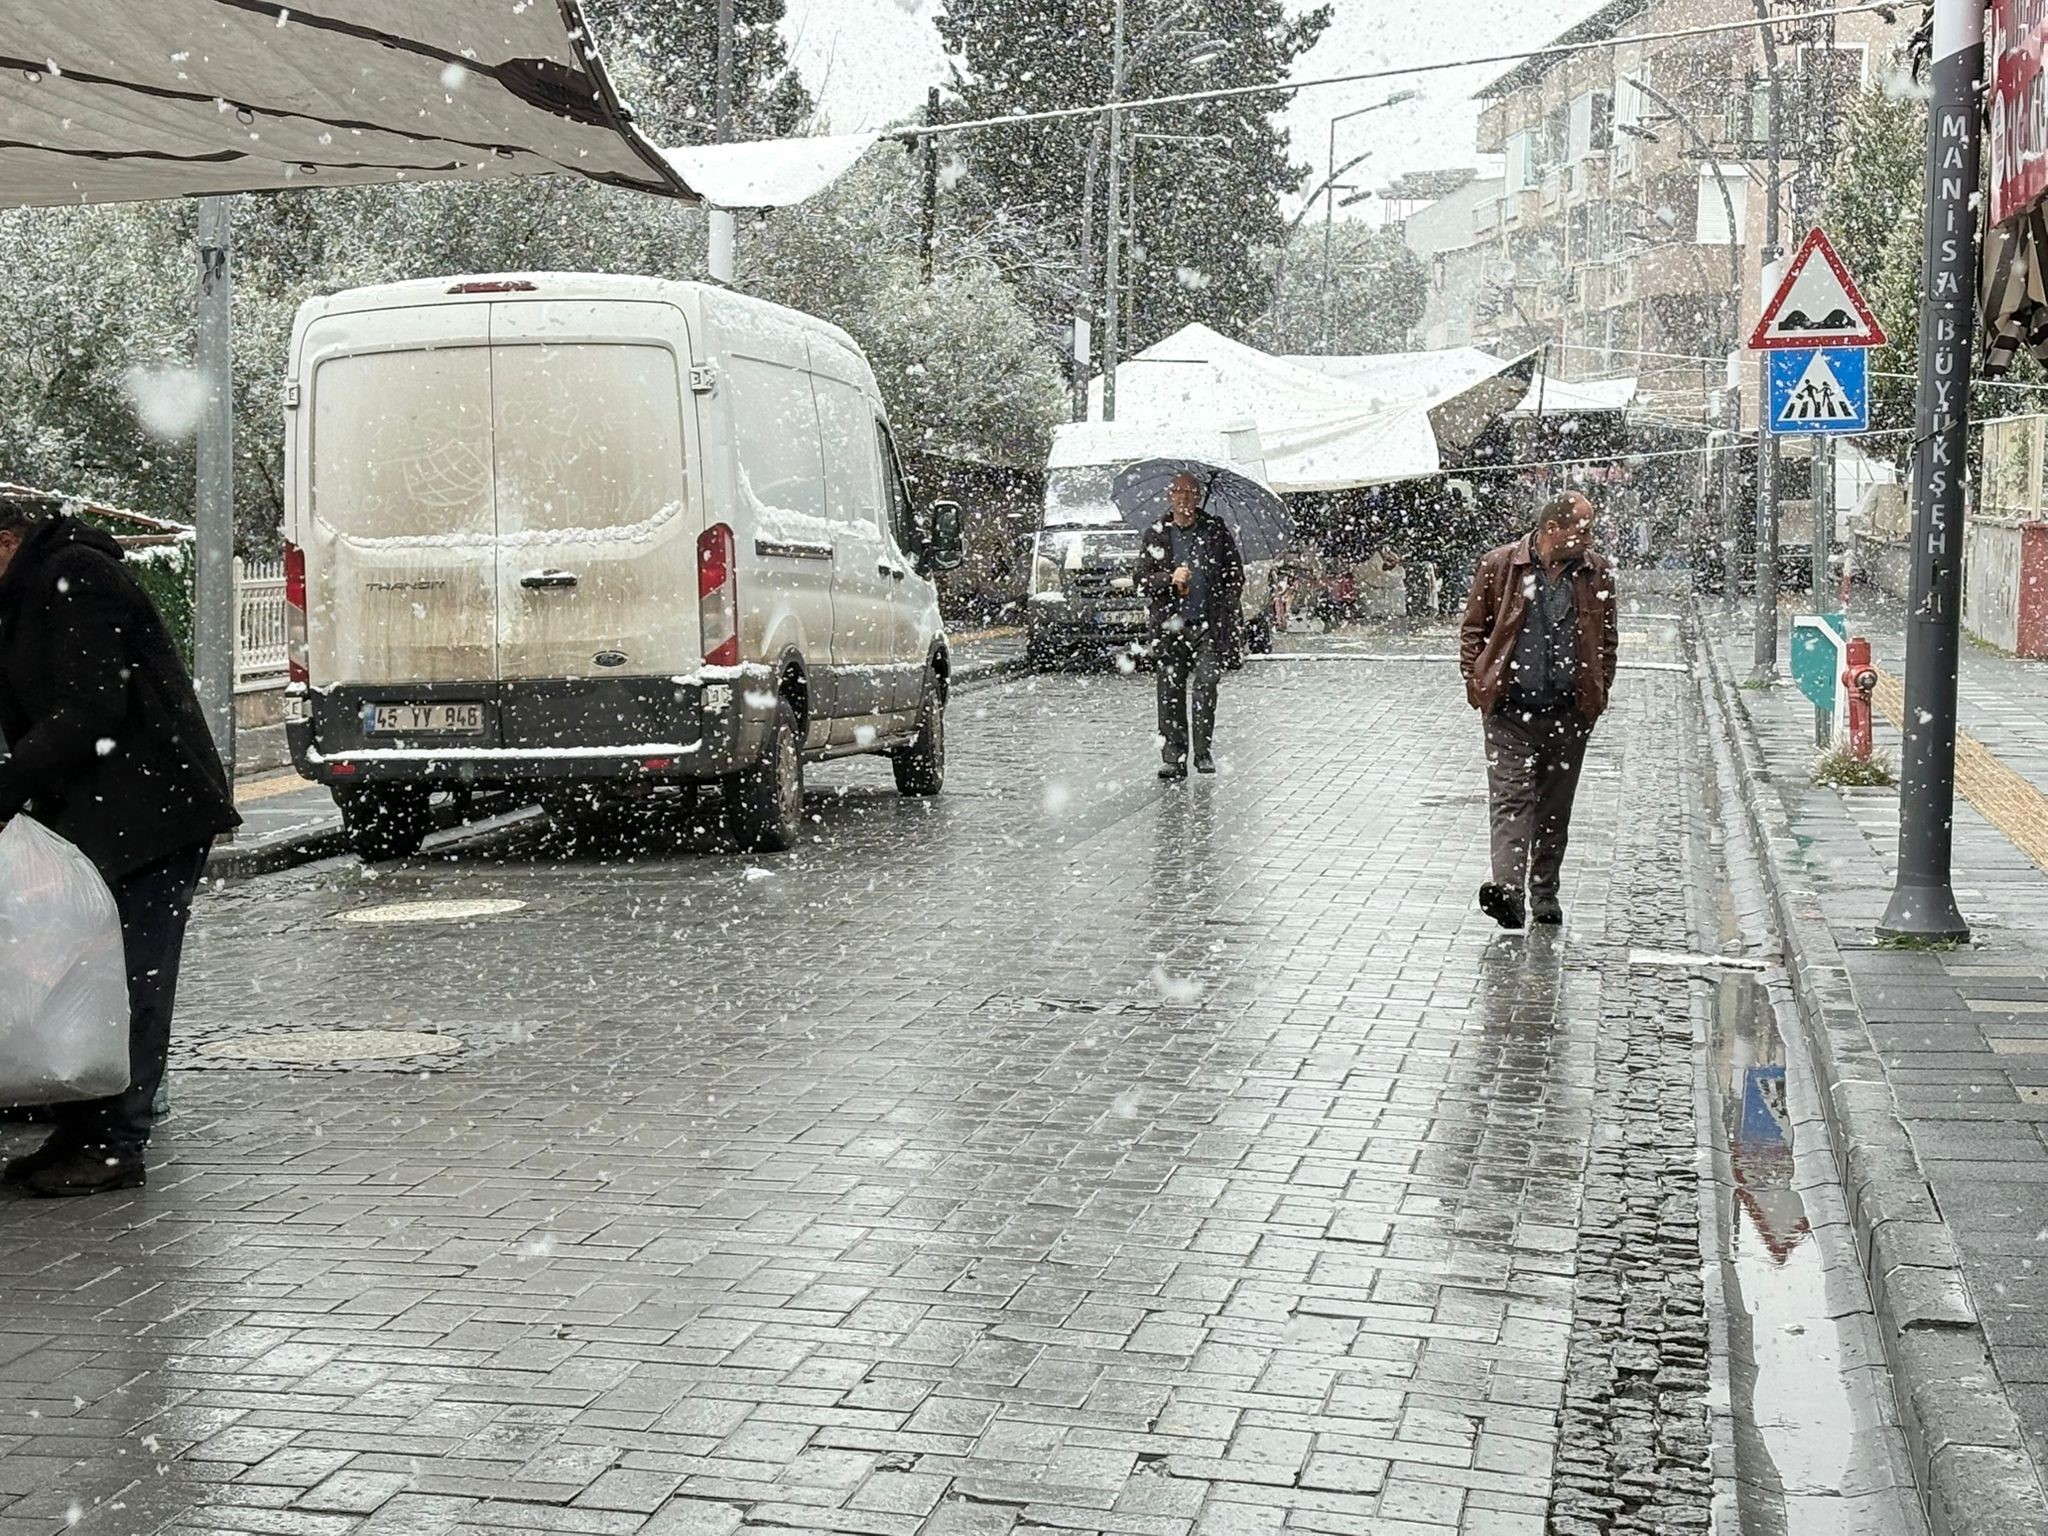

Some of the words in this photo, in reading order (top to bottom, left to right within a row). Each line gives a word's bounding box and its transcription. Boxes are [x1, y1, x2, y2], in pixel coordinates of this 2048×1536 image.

[1938, 113, 1967, 294] MANİSA
[377, 708, 398, 728] 45
[412, 707, 432, 727] YY
